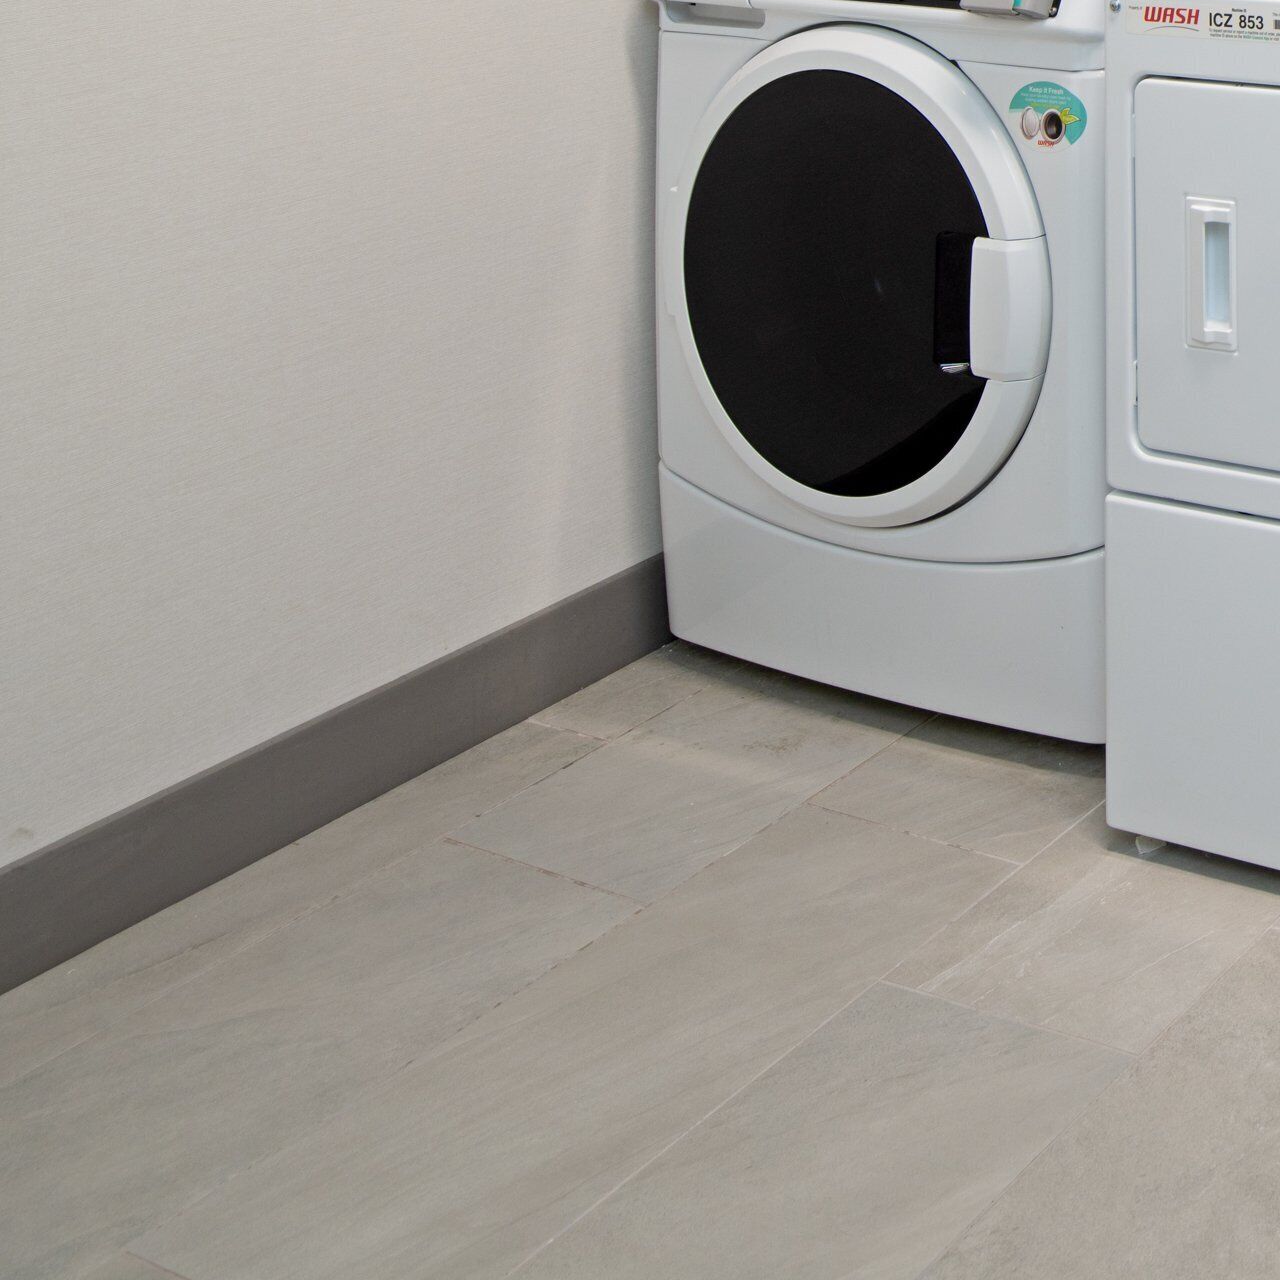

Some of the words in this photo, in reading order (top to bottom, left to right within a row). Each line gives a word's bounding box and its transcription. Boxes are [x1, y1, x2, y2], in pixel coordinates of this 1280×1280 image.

[1144, 6, 1200, 25] WASH
[1209, 13, 1232, 27] ICZ
[1239, 15, 1264, 29] 853
